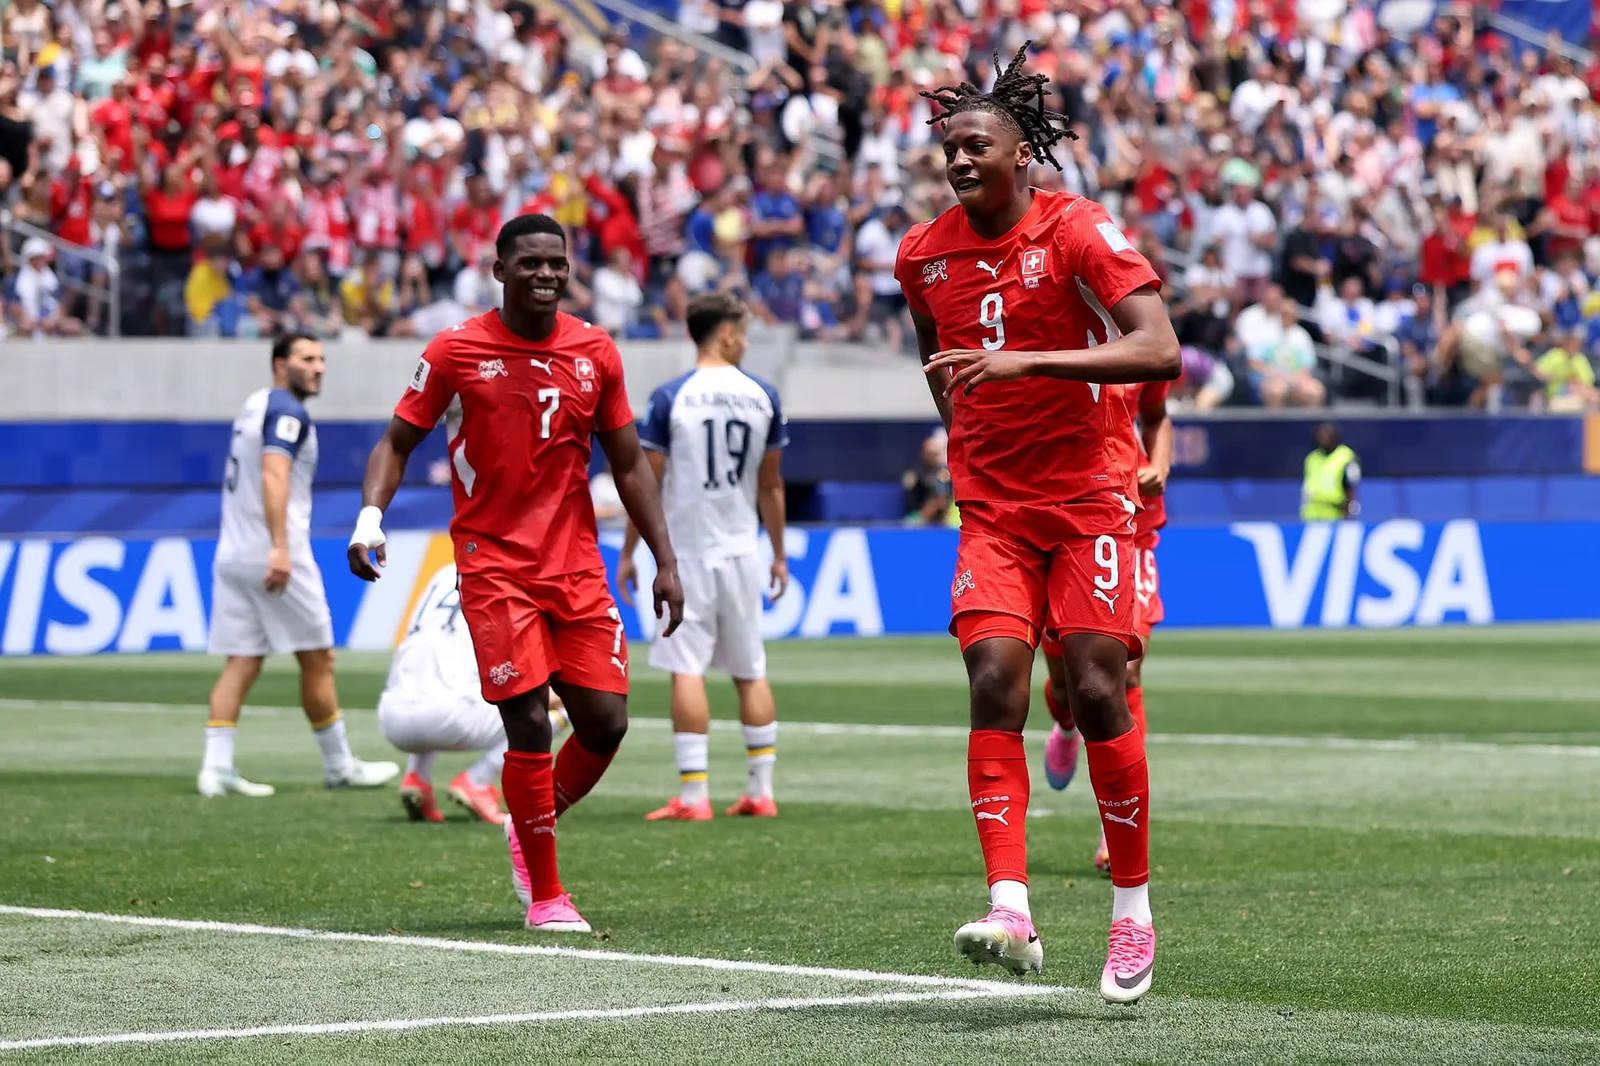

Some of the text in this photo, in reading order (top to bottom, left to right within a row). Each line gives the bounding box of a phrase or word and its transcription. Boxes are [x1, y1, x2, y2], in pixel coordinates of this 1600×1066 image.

[979, 292, 1006, 351] 9
[537, 388, 560, 439] 7
[703, 418, 752, 490] 19
[1094, 534, 1119, 590] 9
[1229, 518, 1495, 628] VISA
[0, 536, 209, 656] ISA
[408, 582, 461, 635] 14
[607, 607, 624, 654] 7
